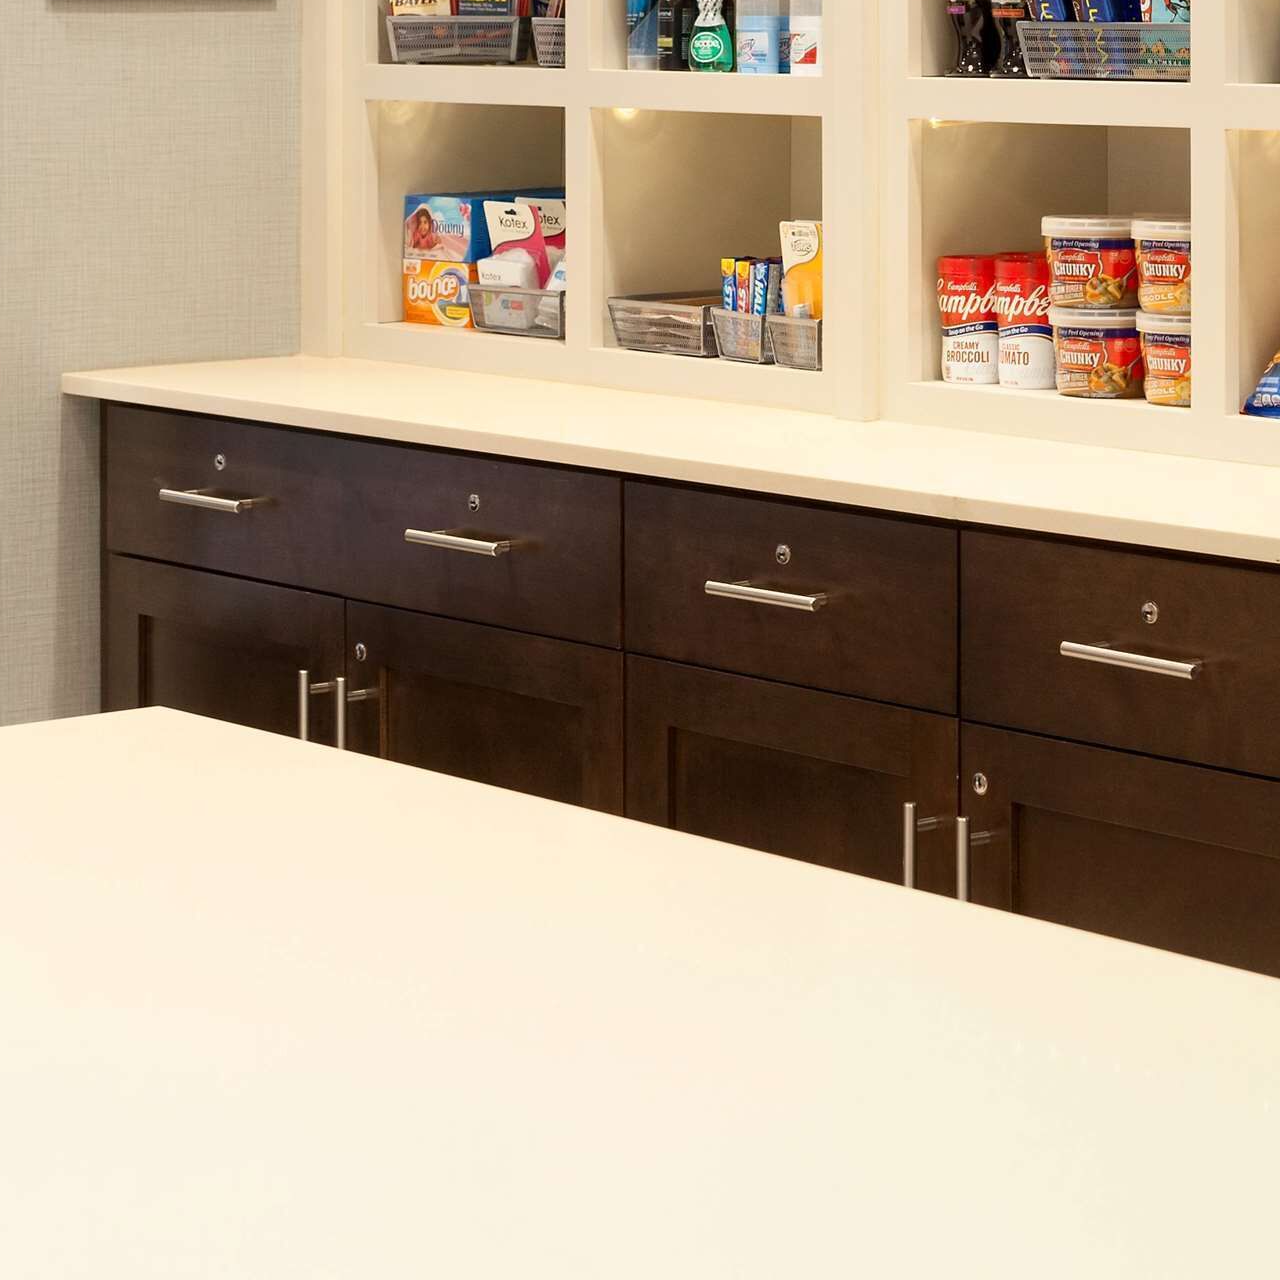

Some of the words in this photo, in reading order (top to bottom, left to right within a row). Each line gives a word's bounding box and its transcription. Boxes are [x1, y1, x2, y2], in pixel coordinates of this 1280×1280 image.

[432, 219, 465, 236] Downy
[498, 215, 528, 230] Kotex
[538, 213, 561, 226] otex
[1053, 260, 1096, 278] CHUNKY
[1143, 261, 1186, 279] CHUNKY
[408, 274, 458, 301] bounce
[953, 341, 979, 350] CREAMY
[946, 350, 990, 363] BROCCOLI
[1060, 351, 1100, 368] CHUNKY
[1147, 355, 1186, 374] CHUNKY
